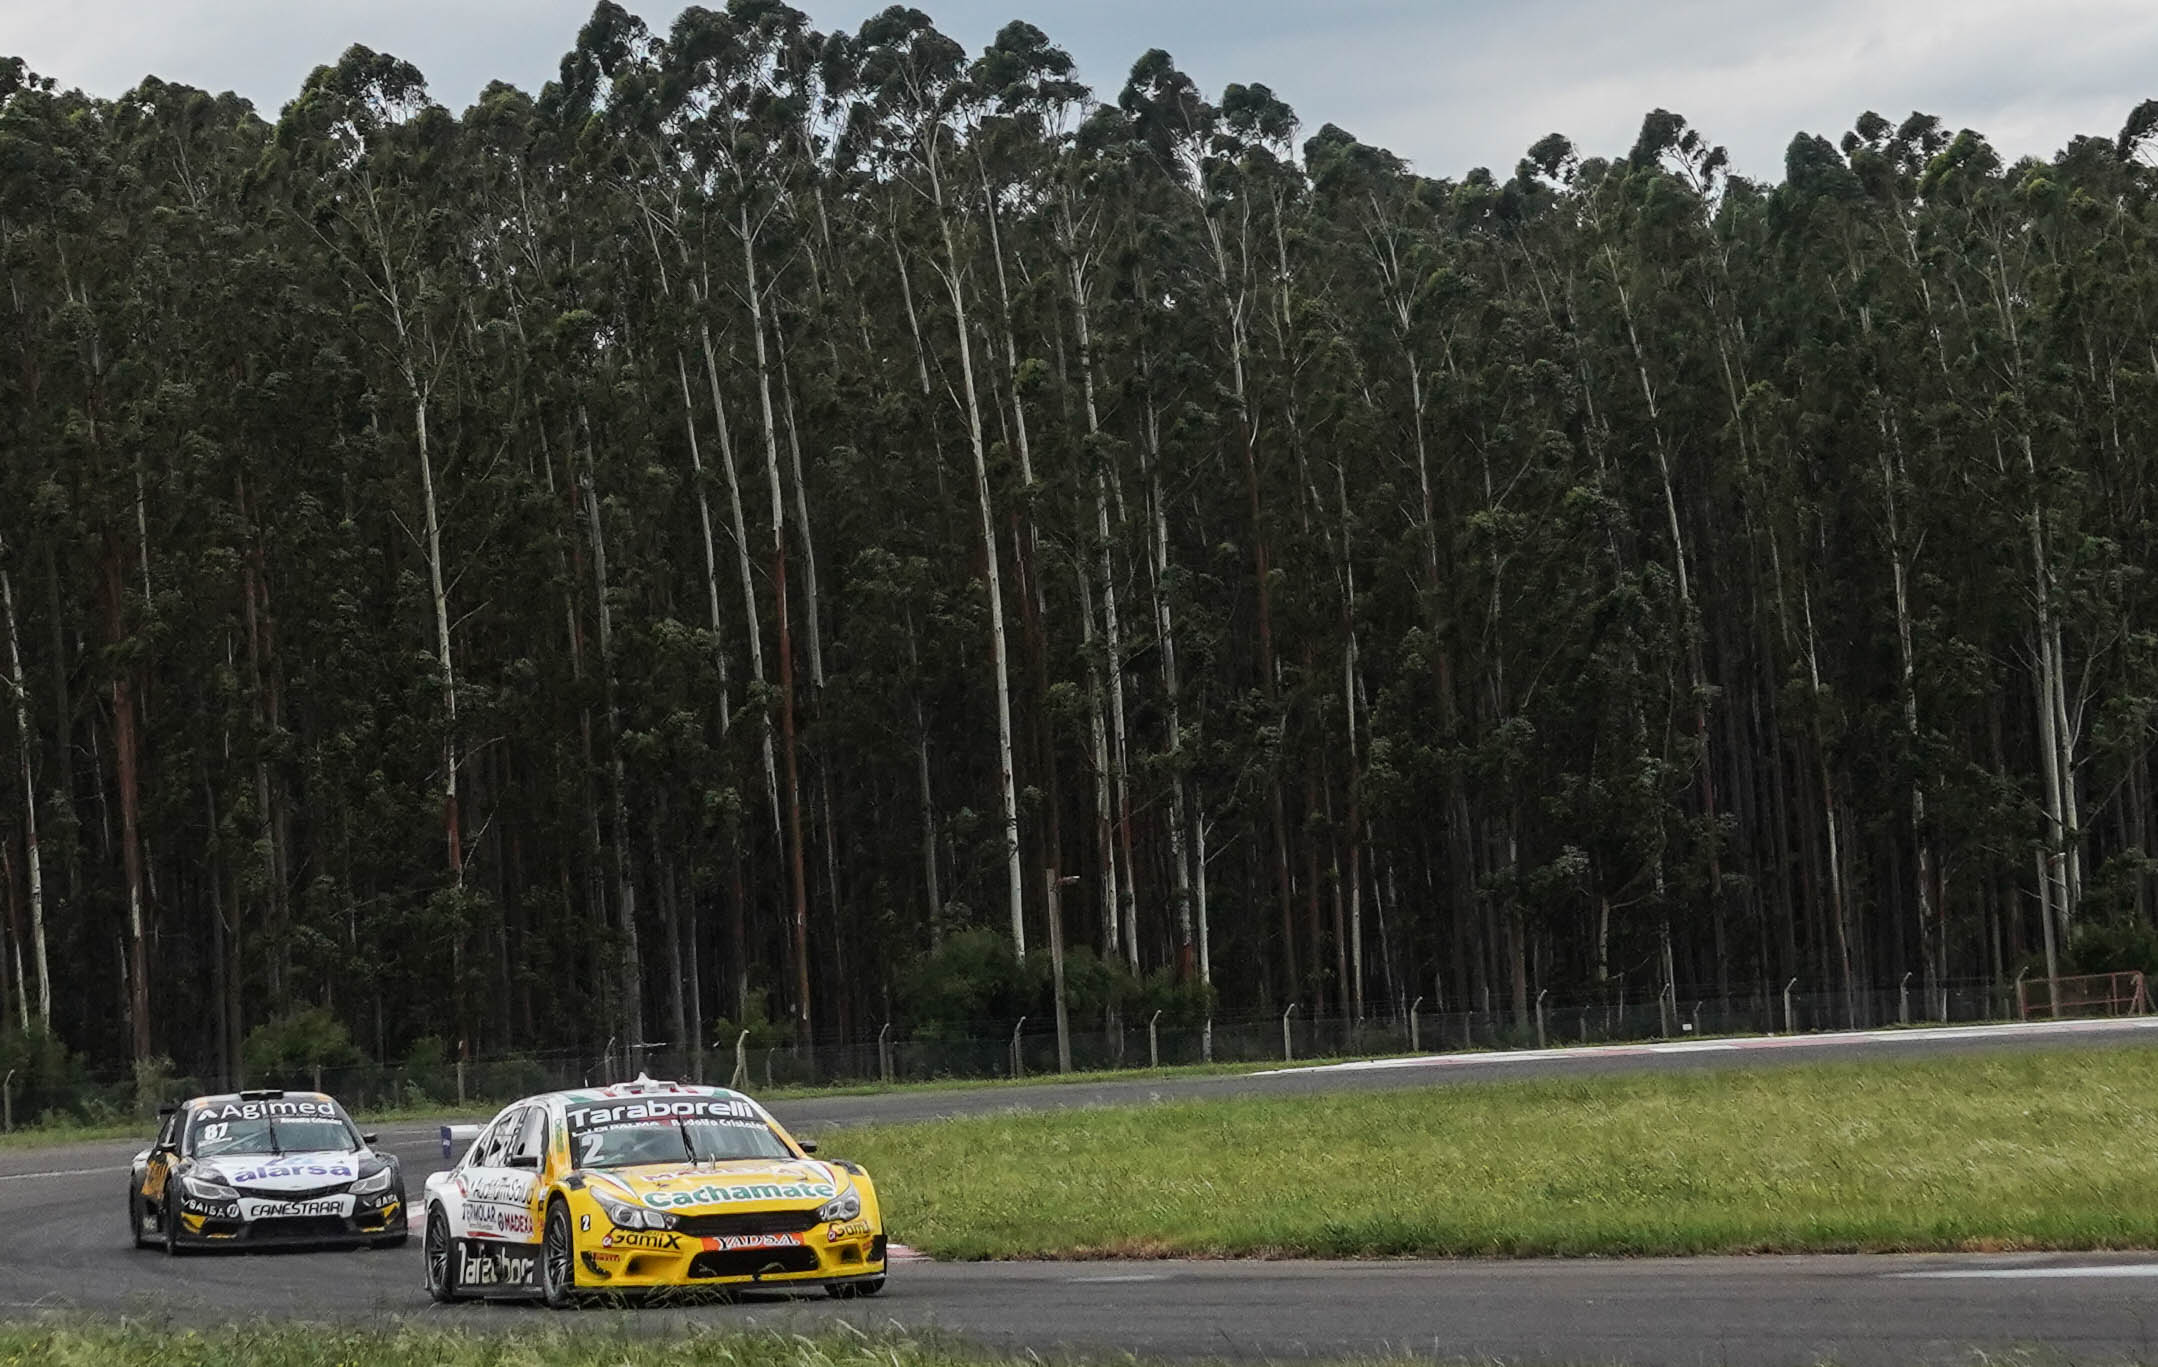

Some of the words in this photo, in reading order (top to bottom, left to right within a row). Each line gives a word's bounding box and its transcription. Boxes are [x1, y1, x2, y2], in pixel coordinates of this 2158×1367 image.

[221, 1101, 336, 1119] Agimed
[567, 1101, 754, 1127] Taraborelli
[204, 1122, 228, 1140] 87
[580, 1133, 605, 1165] 2
[235, 1164, 352, 1182] alarsa
[643, 1184, 835, 1208] Cachamate
[582, 1214, 591, 1231] 2
